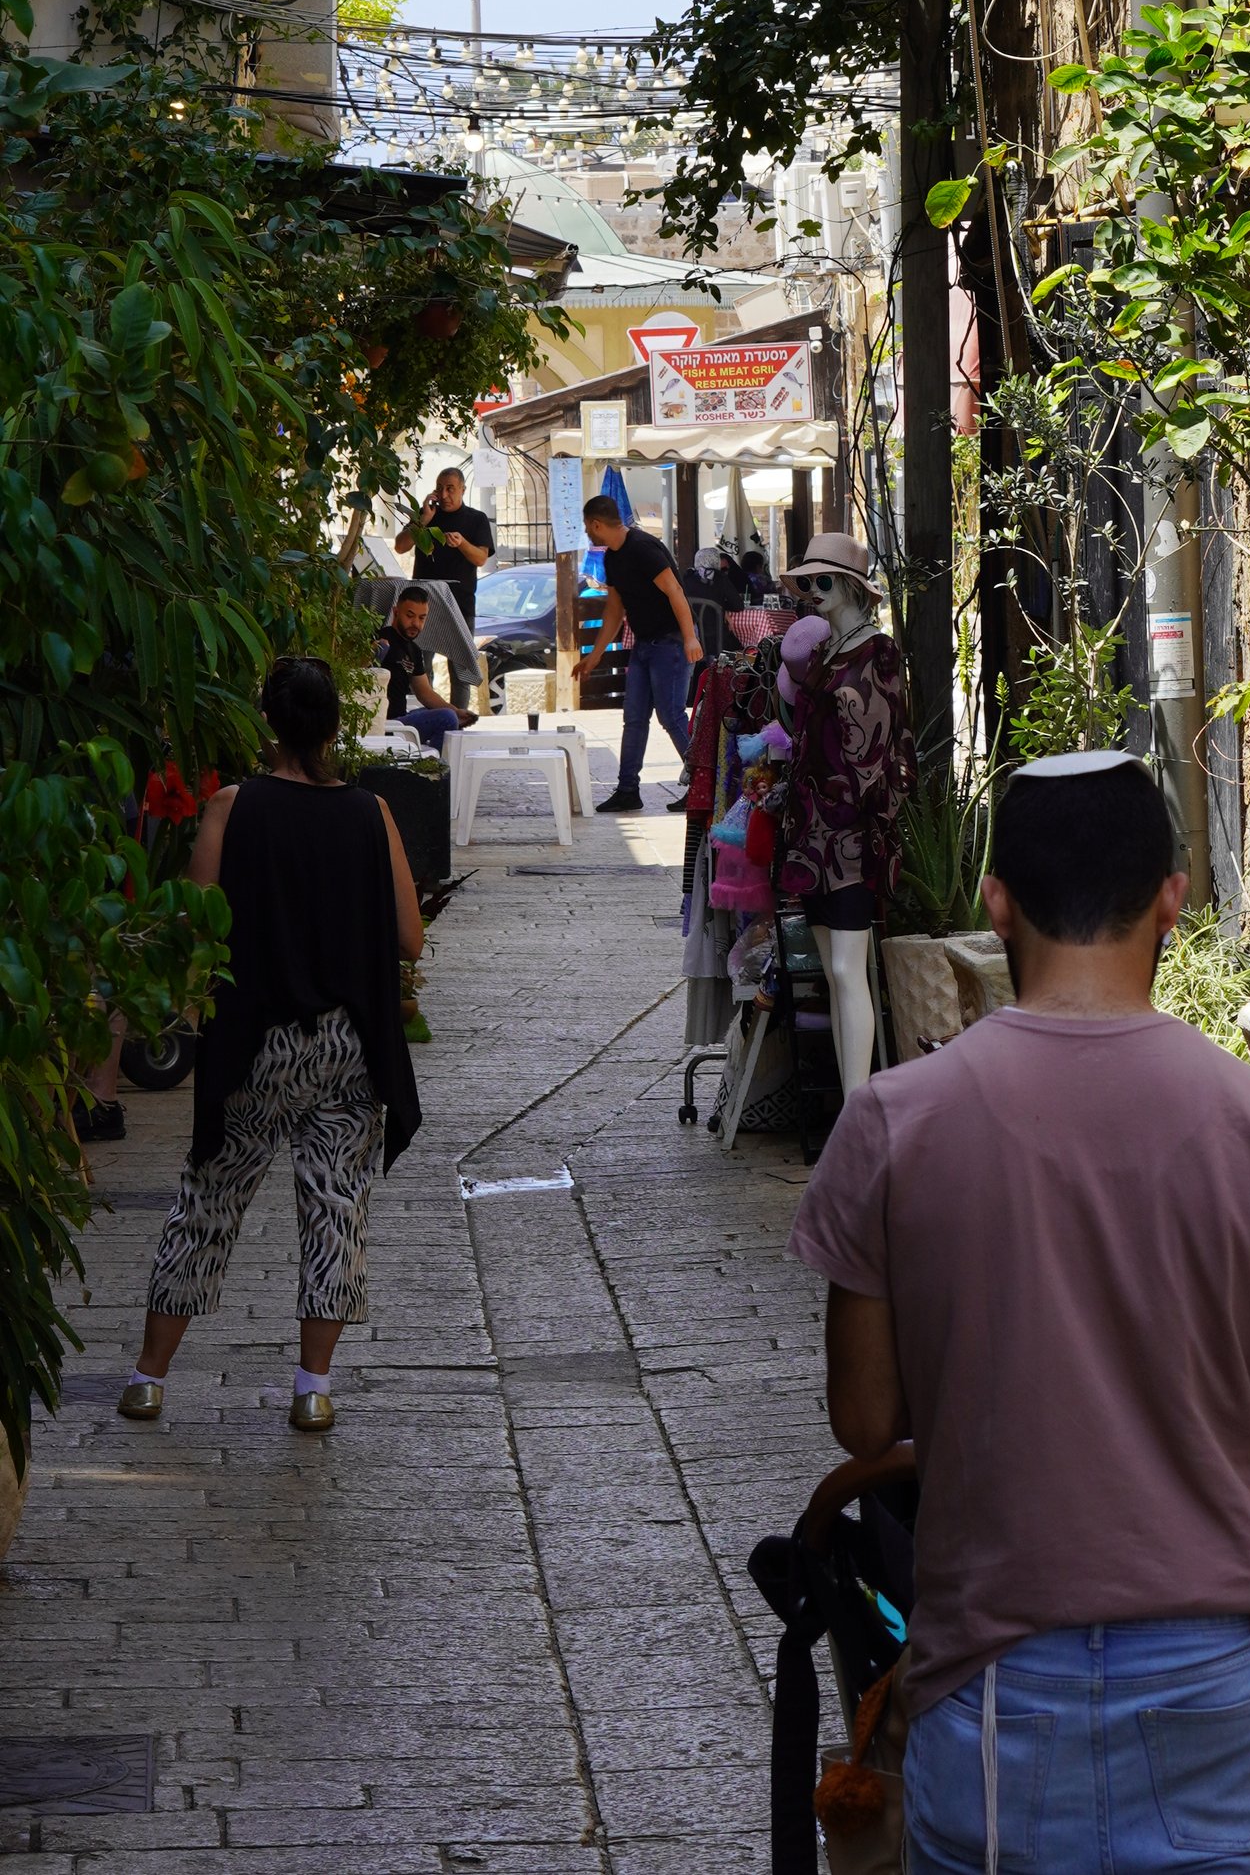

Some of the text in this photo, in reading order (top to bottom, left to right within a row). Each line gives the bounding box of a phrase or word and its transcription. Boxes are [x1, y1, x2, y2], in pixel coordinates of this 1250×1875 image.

[671, 350, 788, 369] מסעדת מאמה קוקה
[681, 365, 778, 378] FISH & MEAT GRIL
[695, 378, 766, 389] RESTAURANT
[695, 412, 735, 421] KOSHER
[739, 411, 766, 419] כשר
